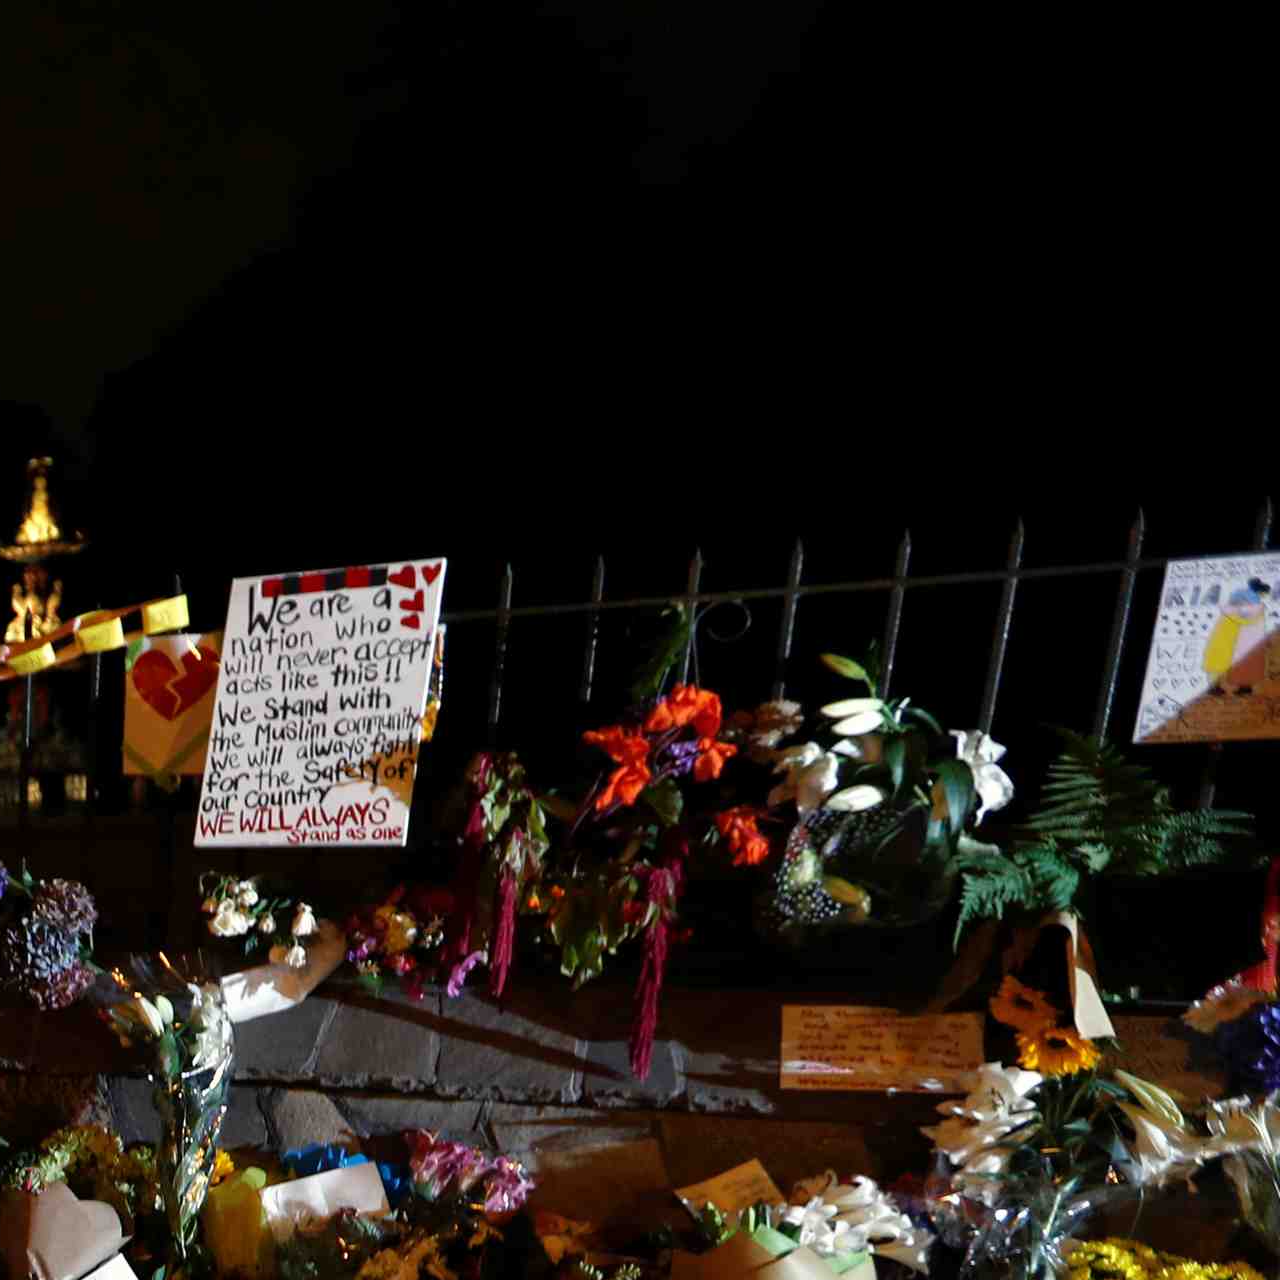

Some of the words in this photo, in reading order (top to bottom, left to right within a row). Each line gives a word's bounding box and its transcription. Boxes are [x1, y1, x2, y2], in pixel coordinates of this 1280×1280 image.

[248, 585, 300, 635] We
[310, 593, 353, 619] are
[373, 588, 392, 609] a
[225, 655, 264, 676] will
[277, 646, 348, 671] never
[355, 632, 430, 663] accept
[231, 630, 313, 656] nation
[226, 674, 273, 695] acts
[282, 671, 319, 692] like
[211, 730, 244, 752] the
[255, 718, 327, 747] Muslim
[334, 706, 420, 736] community
[219, 701, 256, 728] We
[247, 745, 283, 768] will
[296, 734, 368, 765] always
[370, 731, 414, 759] fight
[206, 770, 249, 793] for
[256, 767, 294, 790] the
[384, 758, 414, 783] of
[200, 809, 235, 838] WE
[239, 806, 293, 834] WILL
[296, 797, 390, 828] ALWAYS
[201, 792, 238, 813] our
[346, 826, 367, 840] as
[371, 824, 402, 841] one
